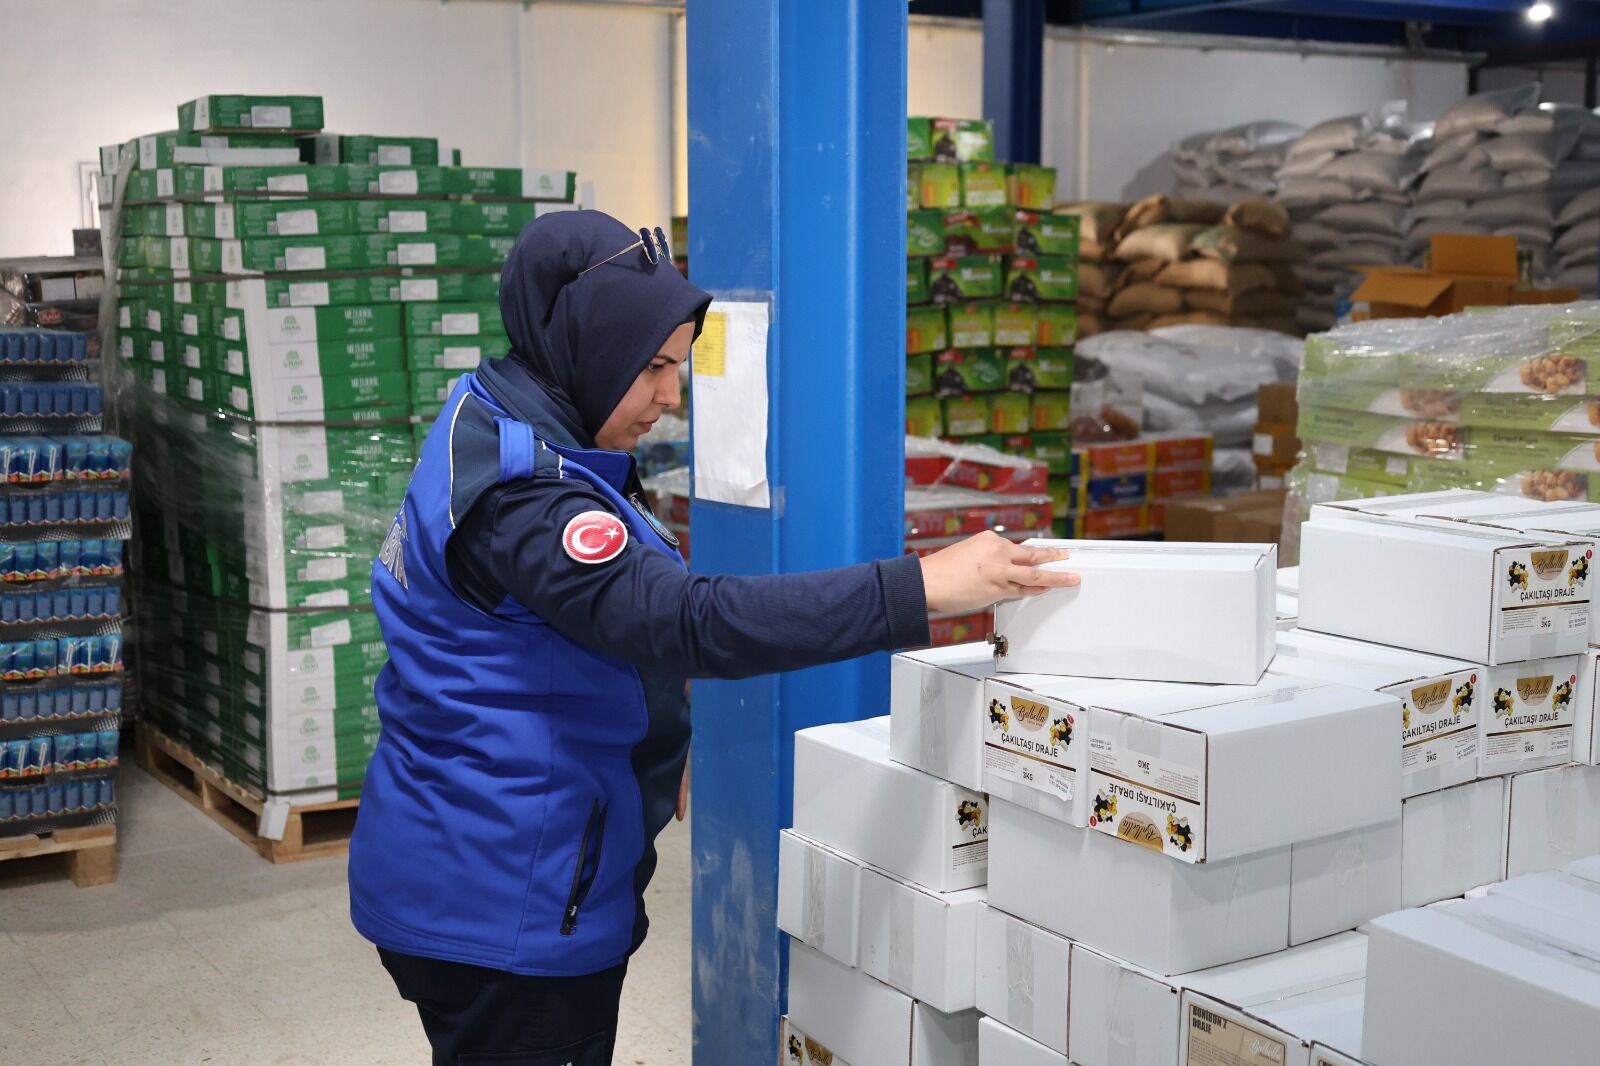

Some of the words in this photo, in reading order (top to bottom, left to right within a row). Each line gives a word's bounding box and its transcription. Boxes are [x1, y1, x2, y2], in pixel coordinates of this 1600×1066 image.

[1520, 590, 1552, 603] ÇAKILTAŞI
[1554, 587, 1575, 598] DRAJE
[1504, 714, 1537, 728] ÇAKILTAŞI
[1538, 711, 1559, 723] DRAJE
[1402, 723, 1437, 741] ÇAKILTAŞI
[1438, 715, 1461, 729] DRAJE
[1001, 733, 1034, 752] ÇAKILTAŞI
[1036, 744, 1059, 758] DRAJE
[1137, 759, 1150, 770] 3KG
[1426, 753, 1437, 763] 3KG
[1108, 783, 1134, 798] DRAJE
[1136, 790, 1177, 813] ÇAKILTAŞI
[1192, 1018, 1212, 1034] DRAJE
